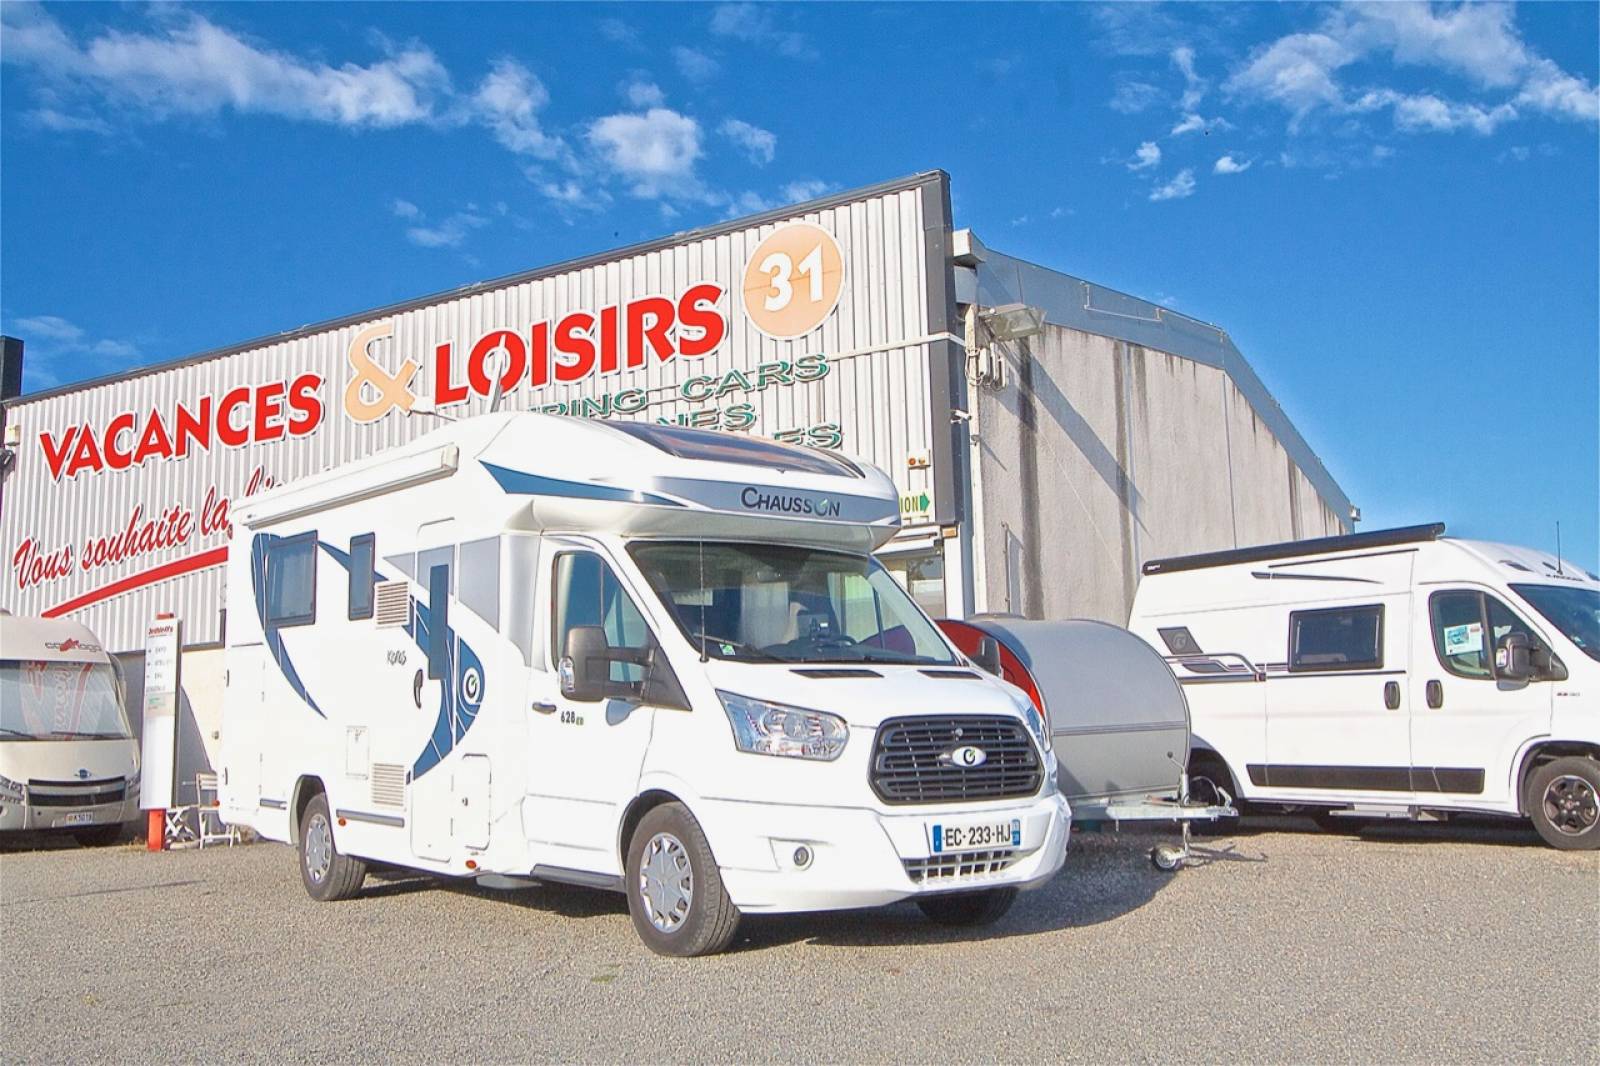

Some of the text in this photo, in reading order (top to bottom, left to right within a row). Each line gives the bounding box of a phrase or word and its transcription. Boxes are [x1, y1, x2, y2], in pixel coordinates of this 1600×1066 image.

[40, 242, 824, 482] VACANCES & LOISIRS 31
[681, 353, 831, 401] CARS
[741, 487, 840, 516] CHAUSSON
[14, 486, 229, 589] Vous souhaite la
[560, 710, 576, 724] 628
